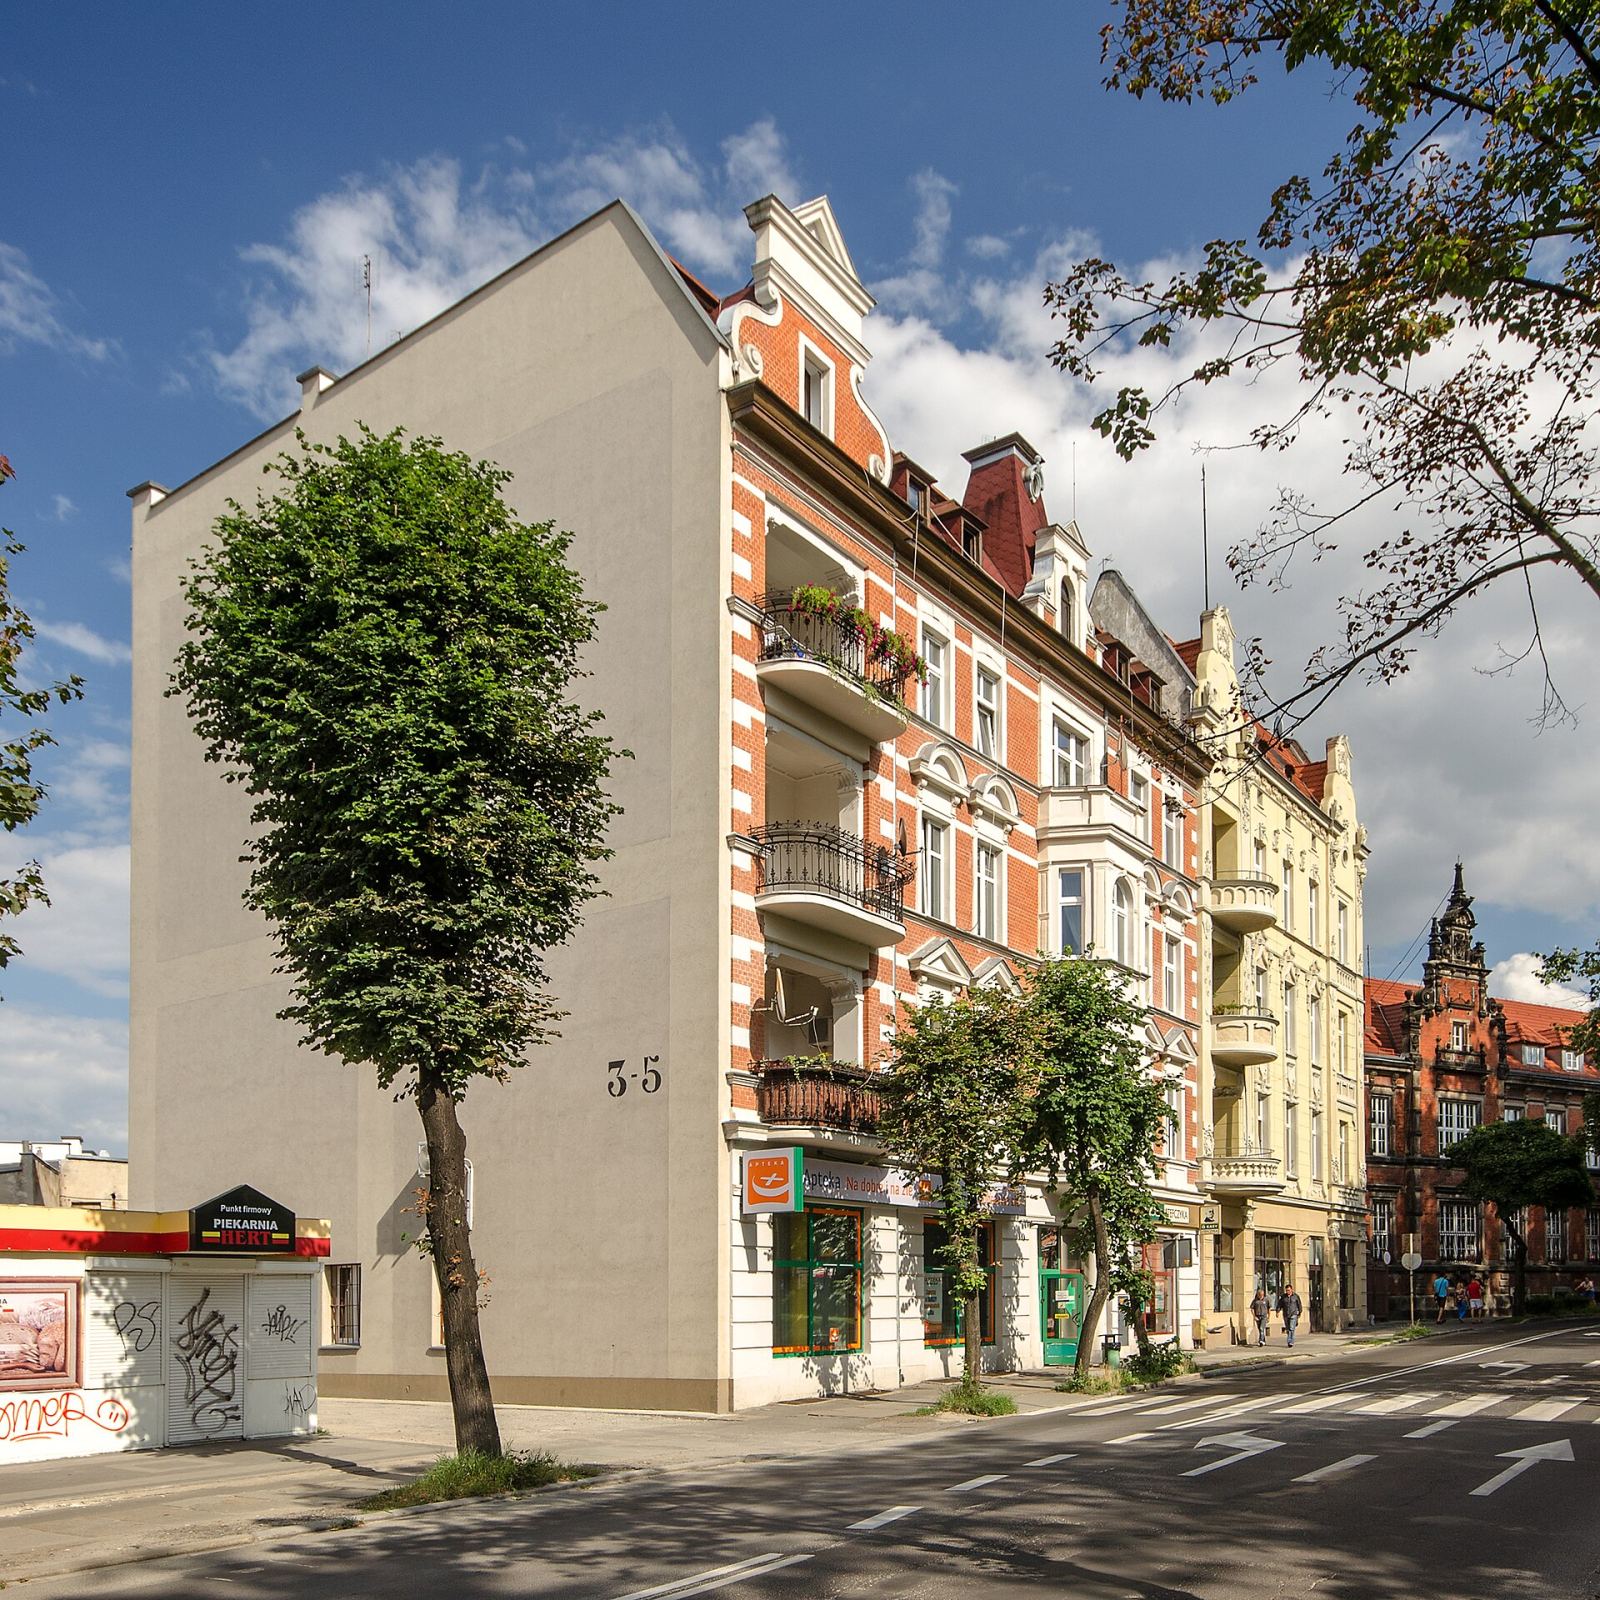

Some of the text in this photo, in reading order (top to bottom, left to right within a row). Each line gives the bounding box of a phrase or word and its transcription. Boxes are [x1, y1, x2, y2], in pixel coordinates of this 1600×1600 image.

[607, 1055, 662, 1097] 3-5
[748, 1160, 785, 1168] APTEKA
[803, 1168, 841, 1190] Apteka
[846, 1176, 859, 1191] Na
[861, 1177, 884, 1193] dobre
[890, 1184, 900, 1196] na
[220, 1204, 272, 1215] Punkt firmowy
[213, 1218, 279, 1231] PIEKARNIA
[220, 1230, 271, 1245] HERT
